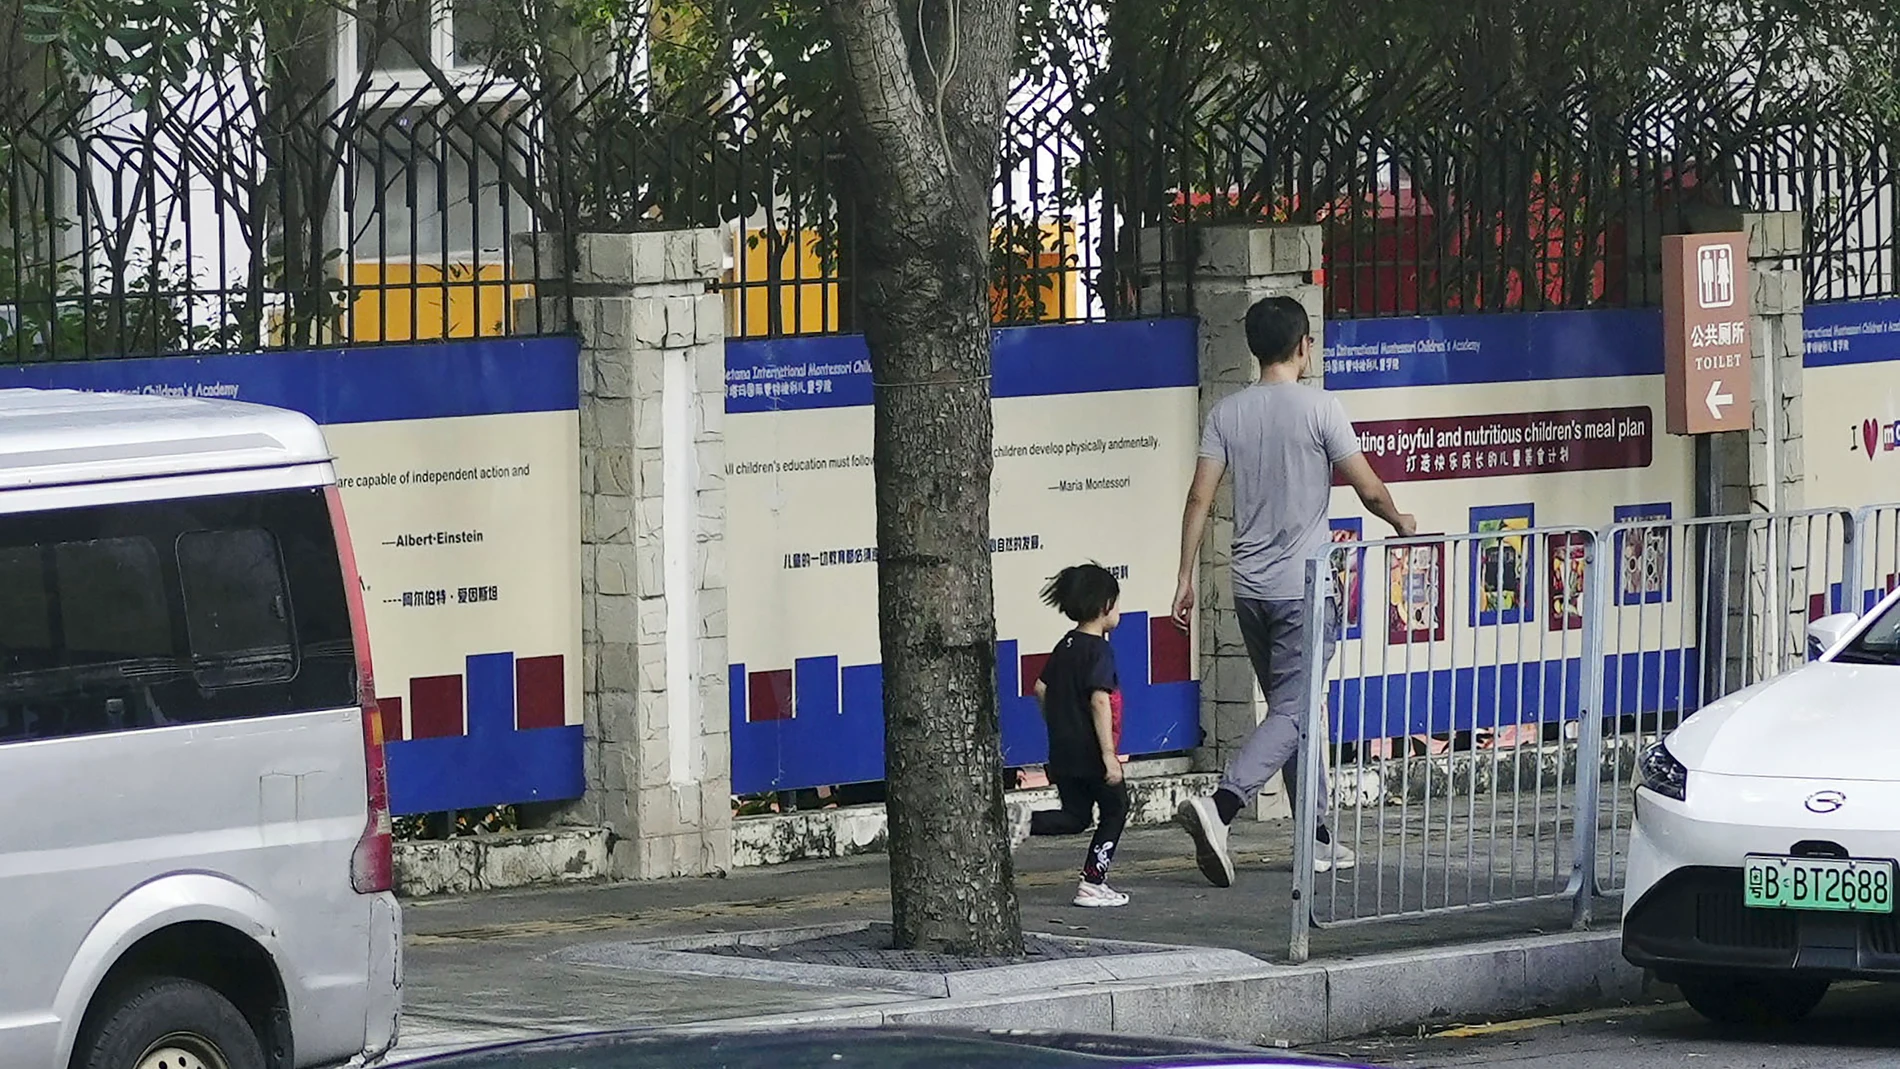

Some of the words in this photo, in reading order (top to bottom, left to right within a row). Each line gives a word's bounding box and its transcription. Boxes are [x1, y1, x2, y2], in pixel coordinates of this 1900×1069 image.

[1336, 341, 1380, 357] International
[1381, 341, 1416, 355] Montessori
[1417, 339, 1450, 354] Children's
[1452, 338, 1481, 354] Academy
[1690, 321, 1745, 348] 公共厕所
[725, 367, 751, 381] etama
[752, 363, 807, 379] International
[808, 360, 852, 377] Montessori
[1695, 353, 1741, 371] TOILET
[195, 381, 239, 398] Academy
[1356, 431, 1385, 457] ating
[1387, 434, 1396, 451] a
[1396, 427, 1434, 455] joyful
[1436, 425, 1462, 447] and
[1464, 423, 1522, 446] nutritious
[1524, 420, 1582, 442] children's
[1584, 417, 1615, 438] meal
[1618, 416, 1645, 442] plan
[1850, 425, 1858, 451] I
[736, 460, 781, 475] children's
[782, 457, 827, 472] education
[828, 457, 850, 469] must
[993, 444, 1028, 458] children
[1029, 442, 1064, 457] develop
[1065, 439, 1107, 456] physically
[1405, 446, 1569, 473] 打造快乐成长的儿童美食计划
[337, 477, 354, 488] are
[356, 472, 397, 489] capable
[400, 471, 410, 484] of
[412, 467, 478, 485] independent
[480, 465, 510, 479] action
[511, 463, 530, 477] and
[1085, 475, 1131, 490] Montessori
